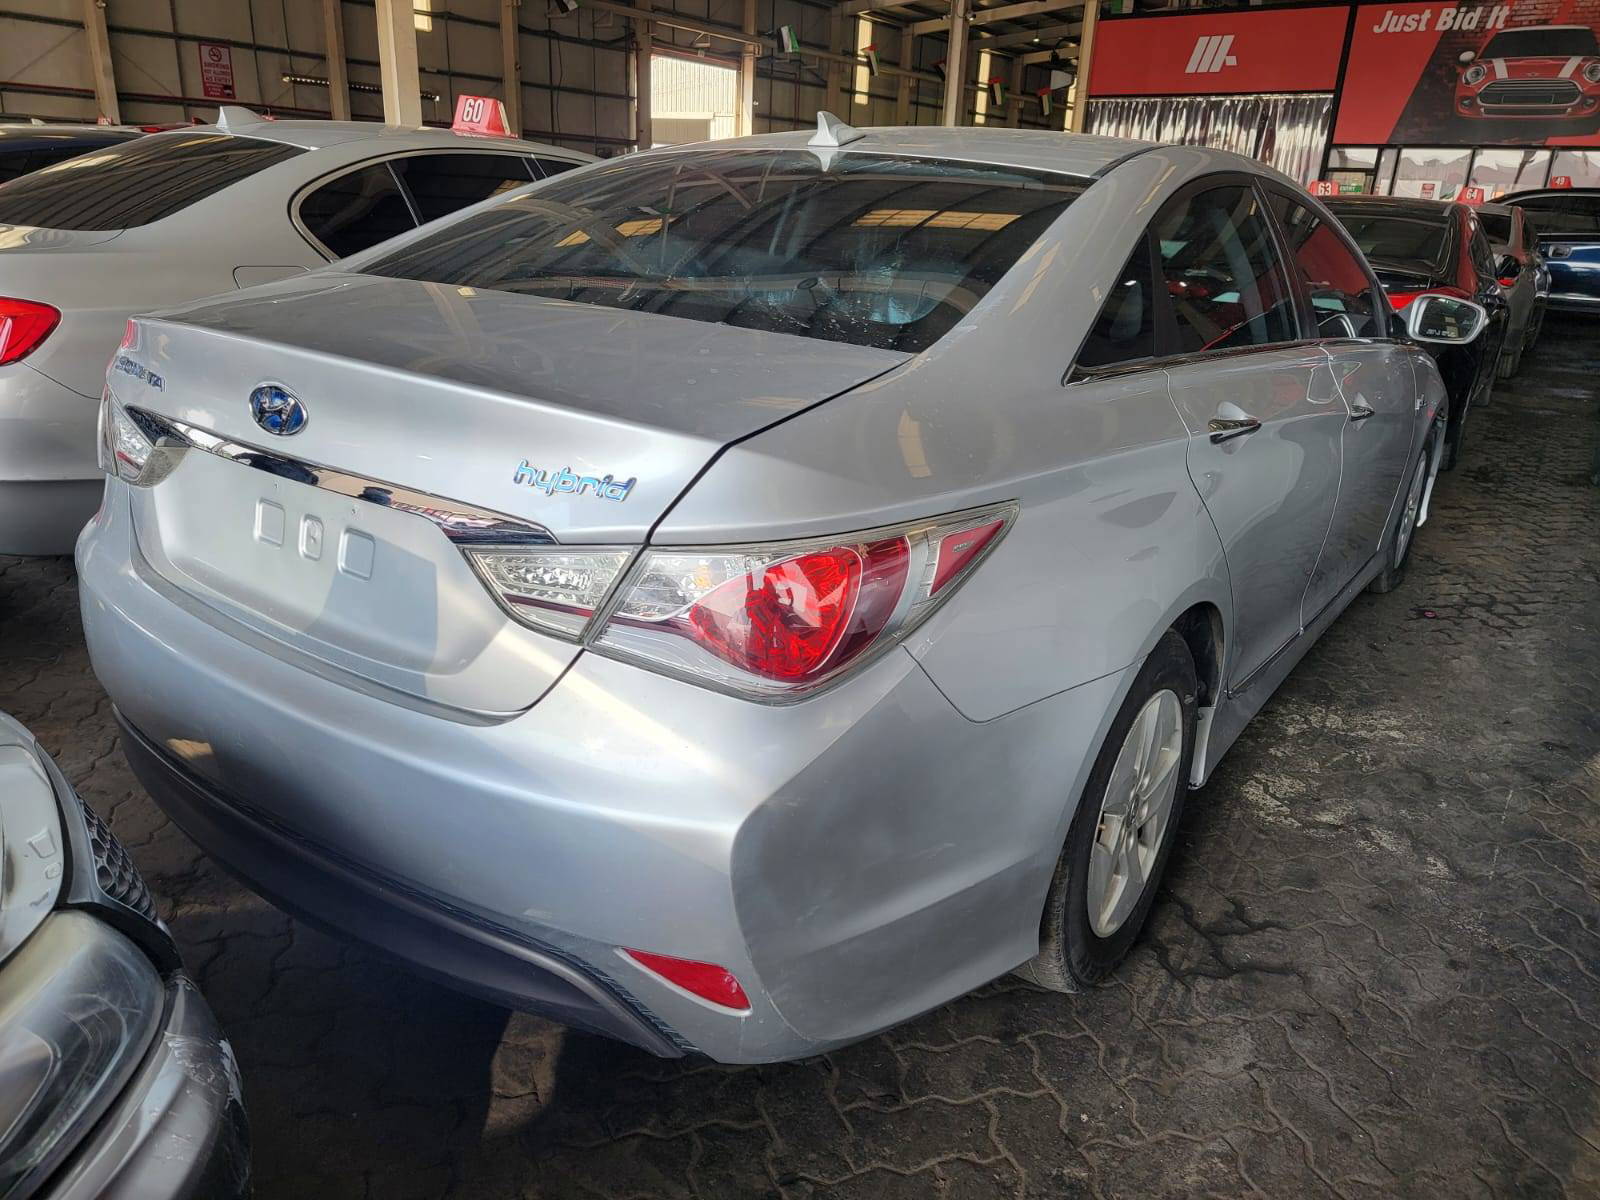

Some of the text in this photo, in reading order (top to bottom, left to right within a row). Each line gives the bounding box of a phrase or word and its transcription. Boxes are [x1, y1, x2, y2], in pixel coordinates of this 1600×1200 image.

[1373, 5, 1510, 33] Just Bid It
[462, 97, 484, 123] 60
[1317, 182, 1333, 196] 63
[1466, 188, 1478, 200] 64
[513, 458, 638, 503] hybrid
